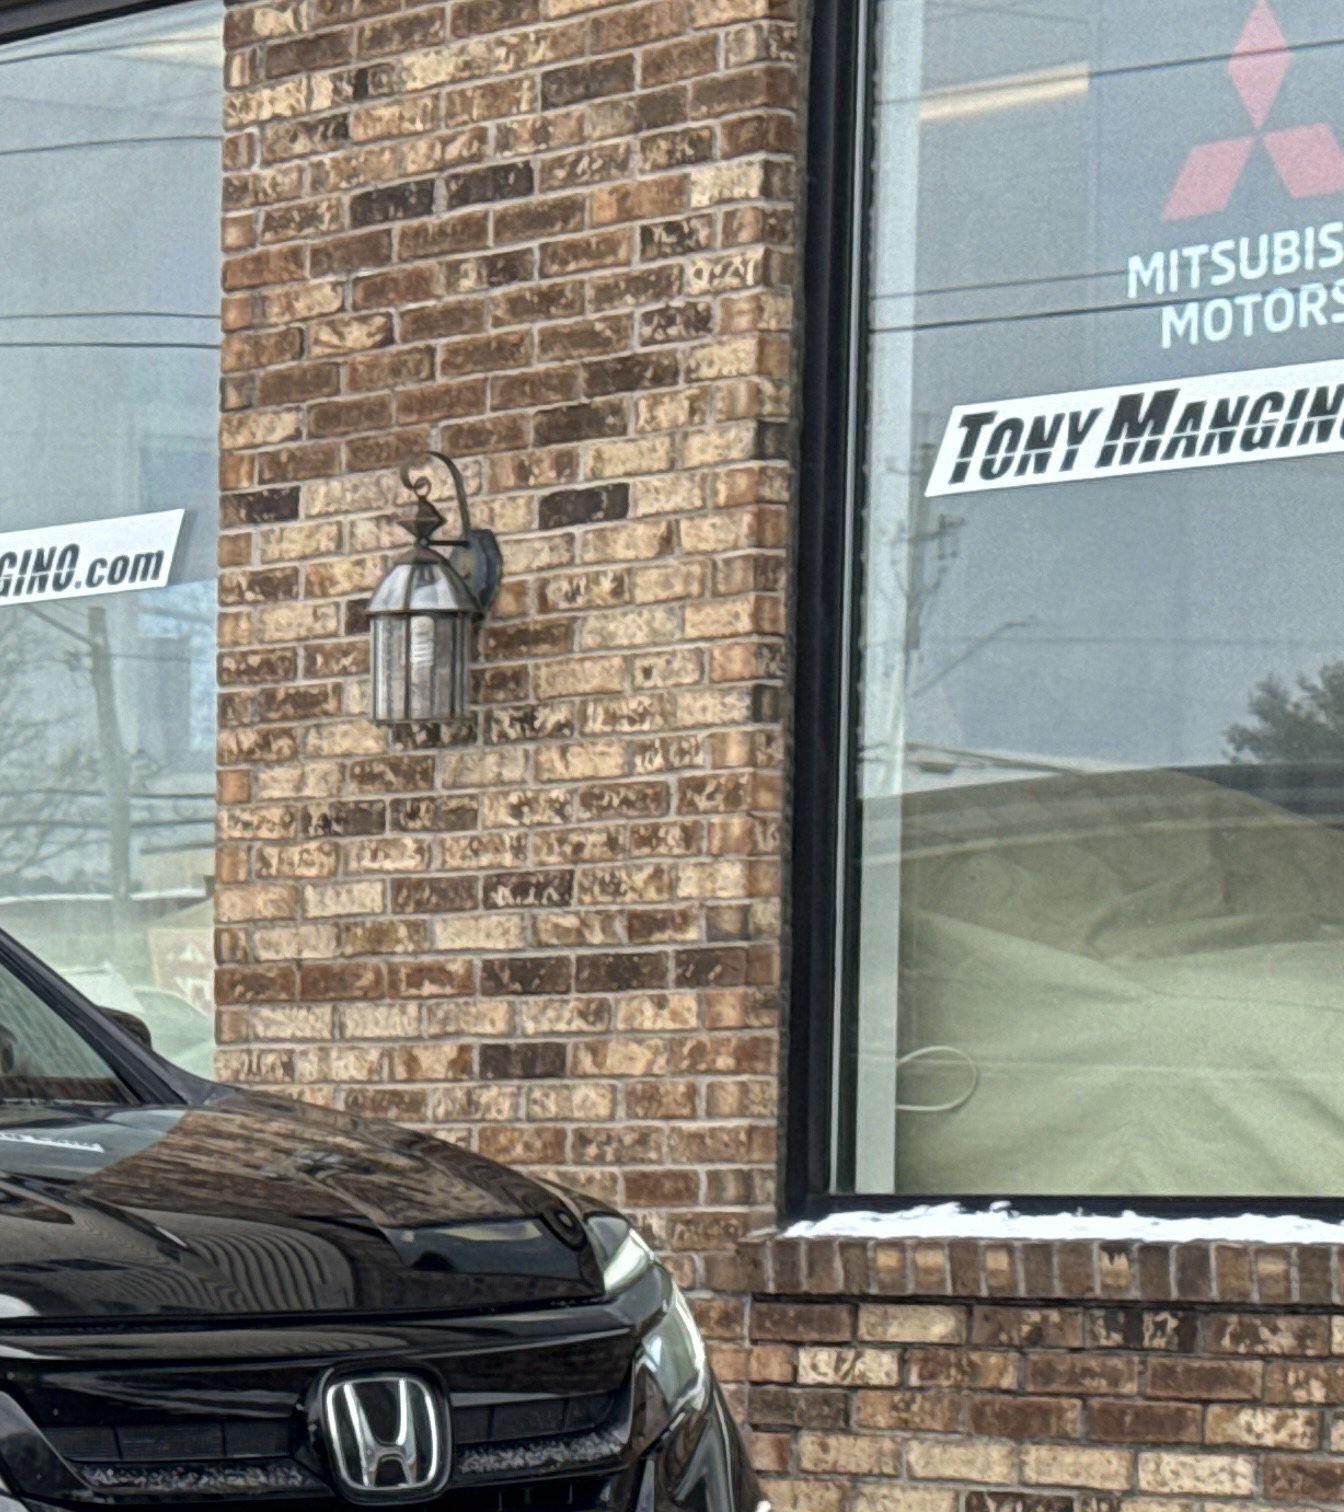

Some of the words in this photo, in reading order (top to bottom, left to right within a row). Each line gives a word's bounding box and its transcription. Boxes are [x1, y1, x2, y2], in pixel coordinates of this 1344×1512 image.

[1127, 221, 1344, 299] MITSUBIS
[1161, 278, 1344, 349] MOTORS
[948, 407, 1104, 485] TONY
[1095, 383, 1344, 468] MANGIN
